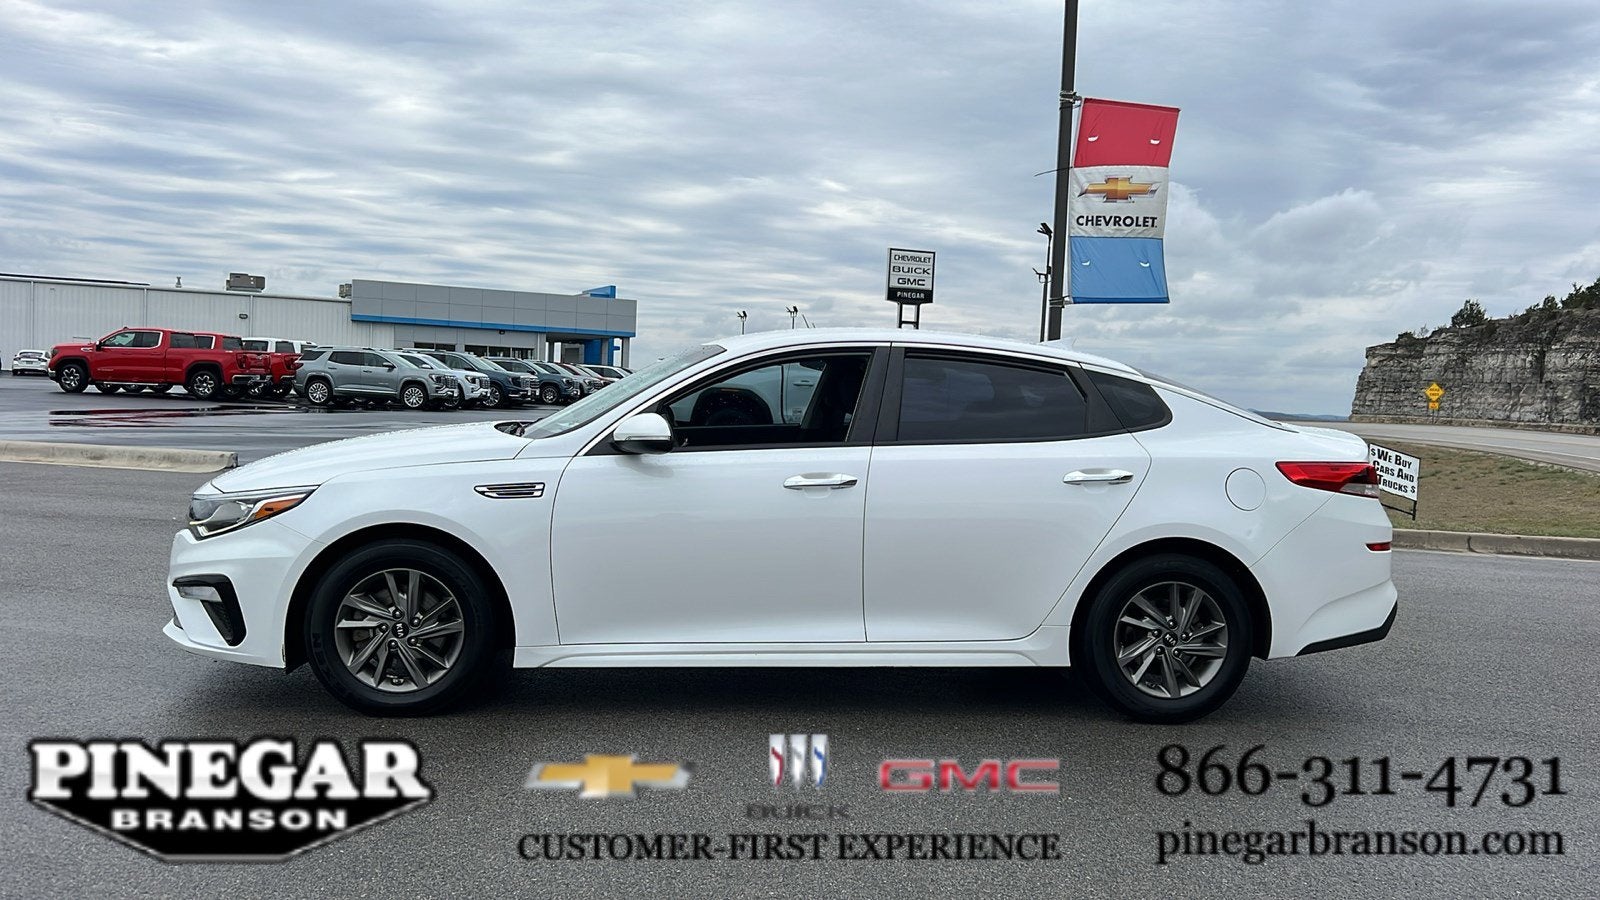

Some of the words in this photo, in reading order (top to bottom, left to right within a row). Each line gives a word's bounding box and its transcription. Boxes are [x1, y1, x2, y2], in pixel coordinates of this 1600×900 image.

[894, 255, 930, 263] CHEVROLET
[893, 266, 930, 275] BUICK
[898, 278, 925, 286] GMC
[897, 291, 924, 299] PINEGAR
[396, 624, 404, 637] KIA
[1165, 634, 1176, 645] KIA
